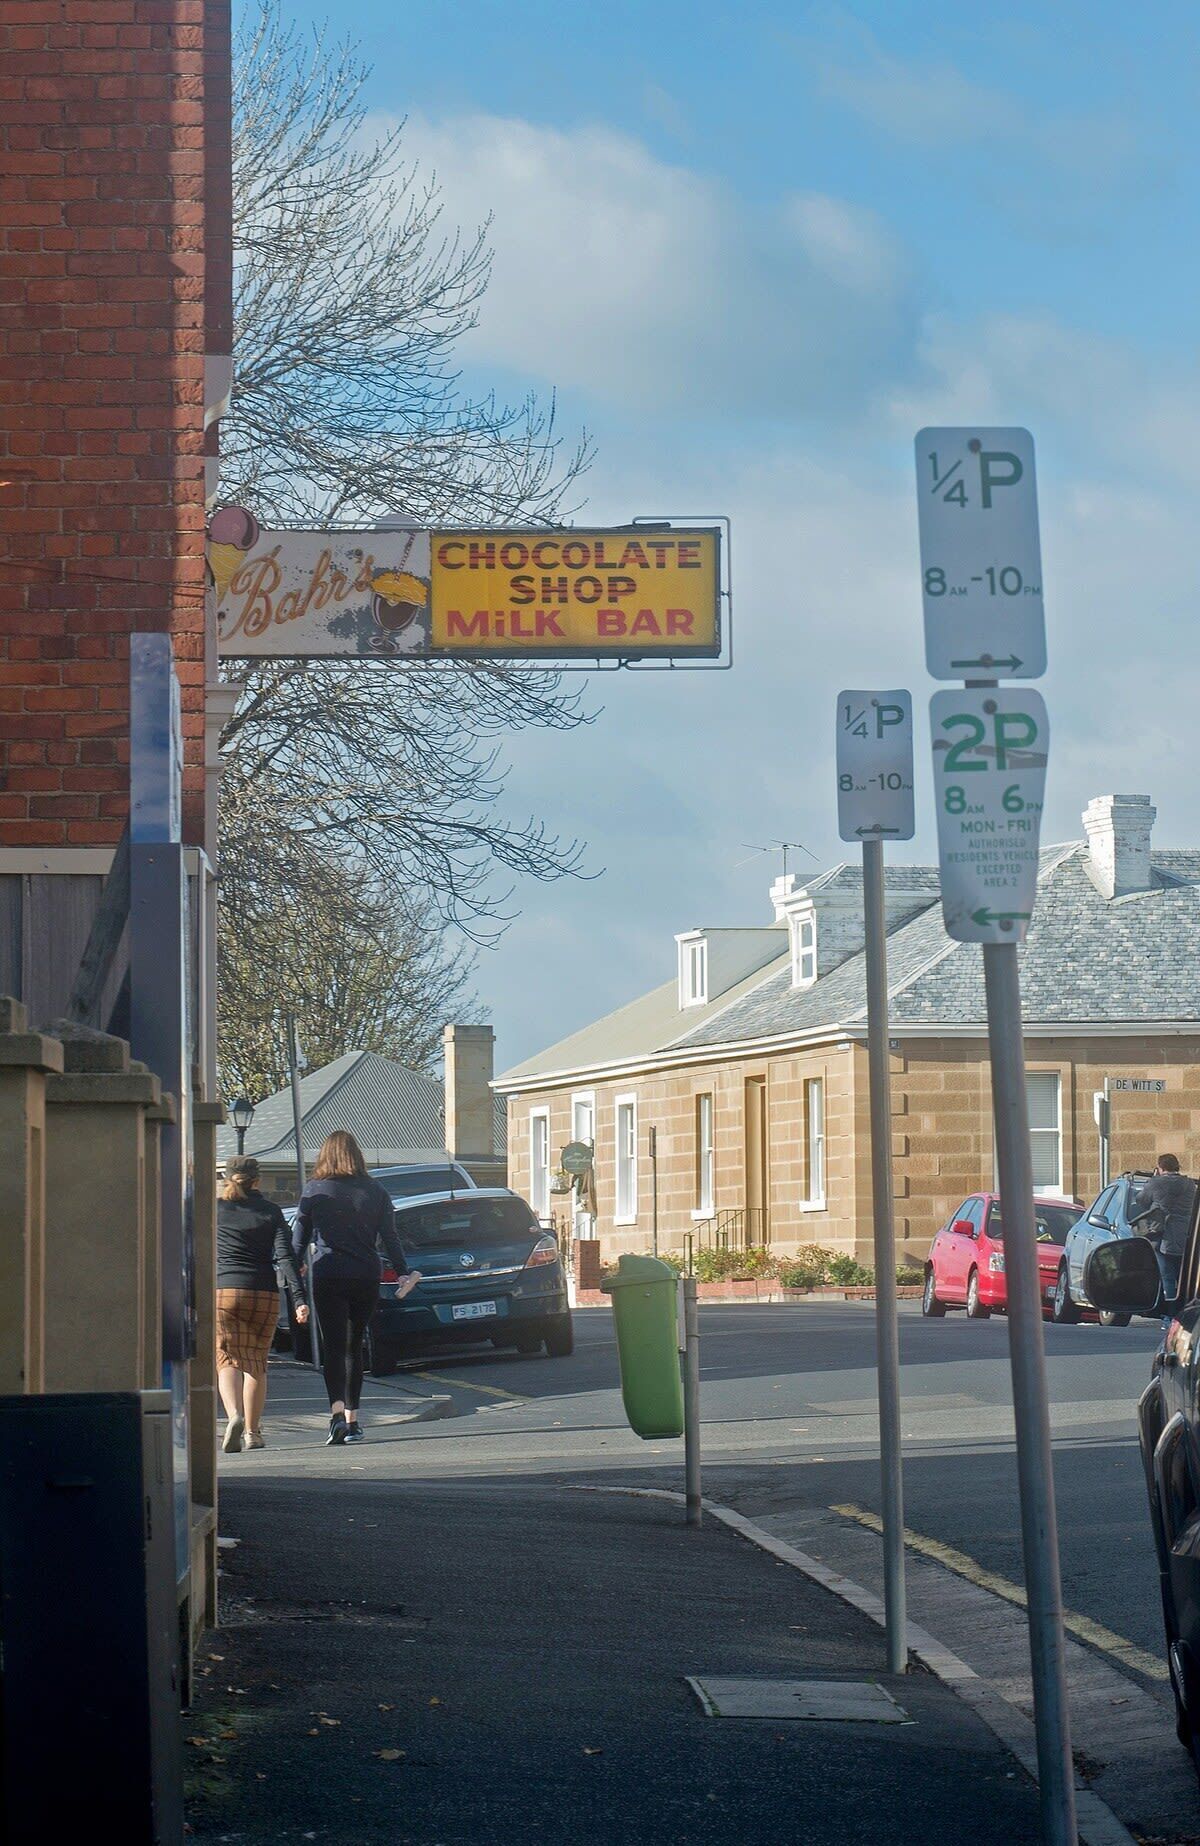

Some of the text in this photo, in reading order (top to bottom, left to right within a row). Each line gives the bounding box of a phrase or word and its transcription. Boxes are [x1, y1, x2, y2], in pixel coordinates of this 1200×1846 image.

[437, 541, 702, 570] CHOCOLATE
[219, 544, 375, 641] Bahr's
[509, 575, 637, 605] SHOP
[596, 608, 696, 637] BAR
[941, 712, 1038, 772] 2P
[968, 838, 1026, 849] AUTHORISED
[975, 863, 1022, 875] EXCEPTED
[983, 877, 1009, 888] AREA
[1116, 1079, 1127, 1090] DE
[1131, 1079, 1151, 1091] WITT
